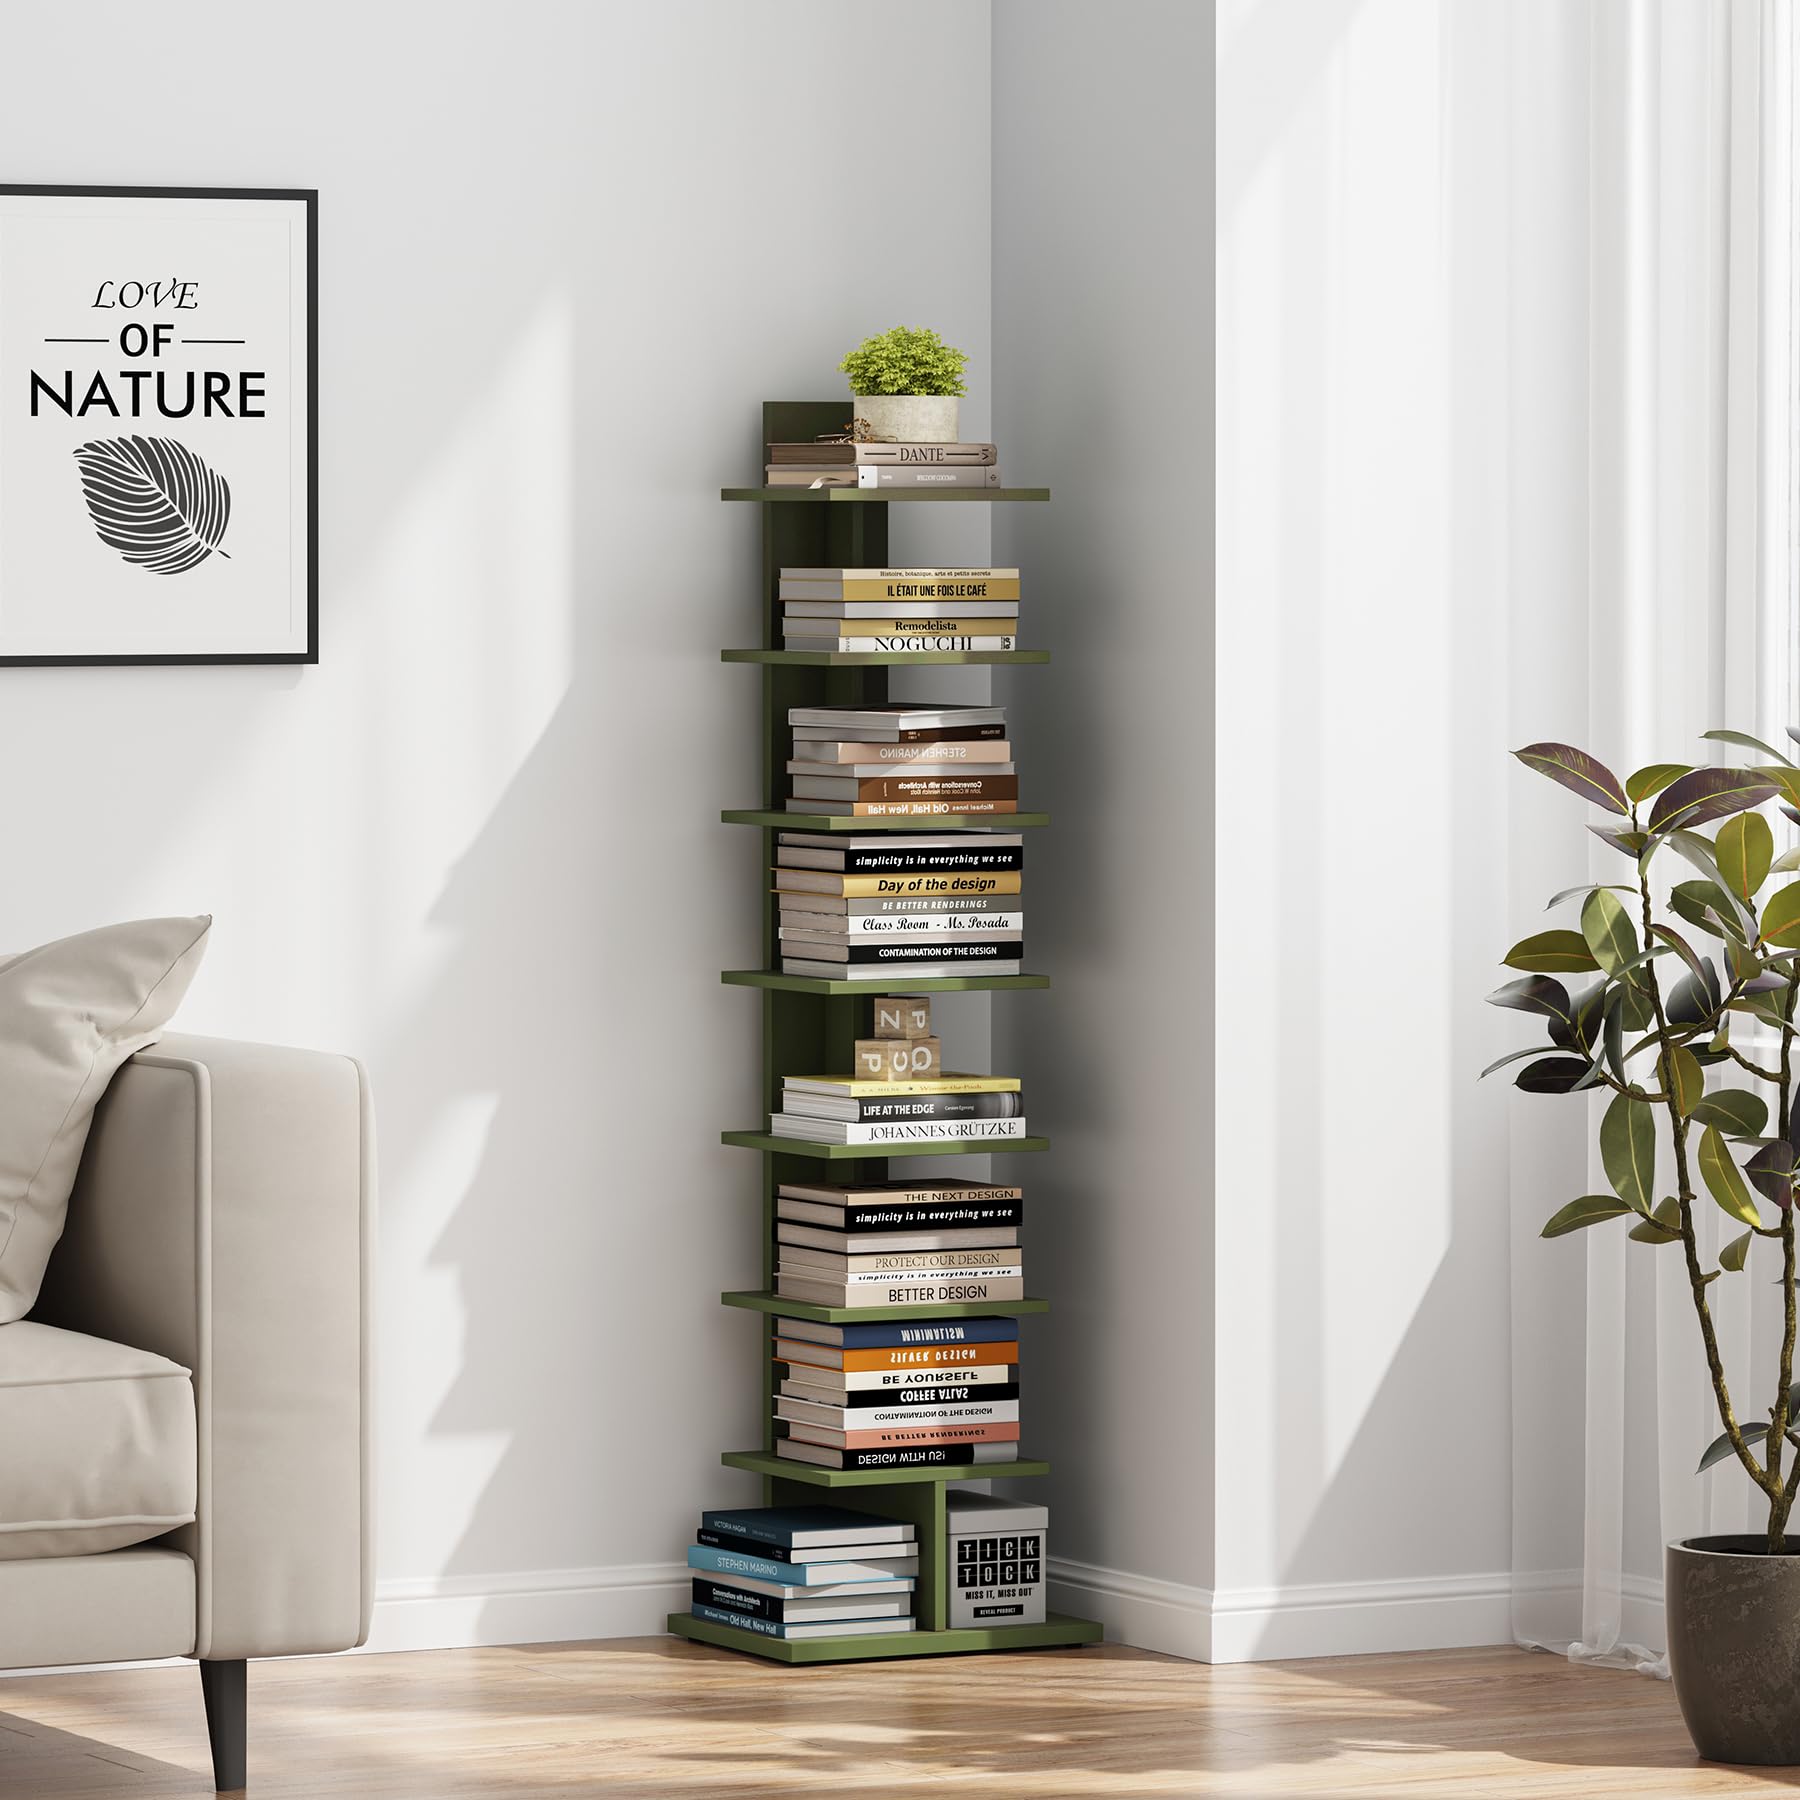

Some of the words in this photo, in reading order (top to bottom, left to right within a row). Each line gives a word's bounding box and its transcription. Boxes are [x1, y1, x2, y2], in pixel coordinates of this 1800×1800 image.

[91, 278, 199, 309] LOVE
[120, 323, 174, 357] OF
[31, 369, 265, 418] NATURE
[900, 448, 944, 461] DANTE
[887, 585, 895, 596] IL
[896, 582, 918, 596] ÉTAIT
[920, 585, 935, 596] UNE
[937, 584, 954, 596] FOIS
[956, 584, 965, 596] LE
[966, 582, 987, 596] CAFÉ
[895, 621, 957, 631] Remodelista
[874, 636, 972, 651] NOGUCHI
[856, 855, 903, 867] simplicity
[906, 855, 914, 864] is
[917, 855, 926, 864] in
[929, 854, 979, 866] everything
[982, 855, 994, 863] we
[878, 879, 904, 893] Day
[908, 878, 923, 890] of
[925, 878, 948, 890] the
[952, 877, 996, 892] design
[883, 902, 893, 910] BE
[896, 901, 927, 910] BETTER
[931, 900, 987, 909] RENDERINGS
[863, 918, 893, 931] Class
[896, 918, 929, 930] Room
[968, 915, 1009, 929] Posada
[879, 948, 941, 958] CONTAMINATION
[942, 948, 953, 956] OF
[953, 947, 968, 956] THE
[969, 947, 997, 955] DESIGN
[912, 1010, 926, 1029] P
[862, 1053, 881, 1072] P
[912, 1047, 932, 1071] Q
[863, 1106, 880, 1116] LIFE
[882, 1105, 893, 1115] AT
[894, 1104, 911, 1115] THE
[912, 1104, 934, 1114] EDGE
[868, 1125, 945, 1141] JOHANNES
[948, 1121, 1017, 1137] GRÜTZKE
[904, 1193, 928, 1202] THE
[932, 1192, 964, 1200] NEXT
[968, 1190, 1014, 1199] DESIGN
[856, 1213, 903, 1224] simplicity
[906, 1212, 914, 1220] is
[917, 1211, 926, 1220] in
[929, 1209, 979, 1221] everything
[998, 1209, 1013, 1217] see
[875, 1256, 928, 1268] PROTECT
[930, 1255, 955, 1266] OUR
[958, 1253, 1000, 1265] DESIGN
[858, 1273, 904, 1281] simplicity
[930, 1270, 978, 1278] everything
[889, 1288, 935, 1302] BETTER
[938, 1285, 987, 1300] DESIGN
[717, 1557, 748, 1572] STEPHEN
[749, 1562, 778, 1576] MARINO
[965, 1590, 984, 1600] MISS
[986, 1590, 995, 1600] IT,
[997, 1588, 1016, 1598] MISS
[729, 1615, 740, 1626] Old
